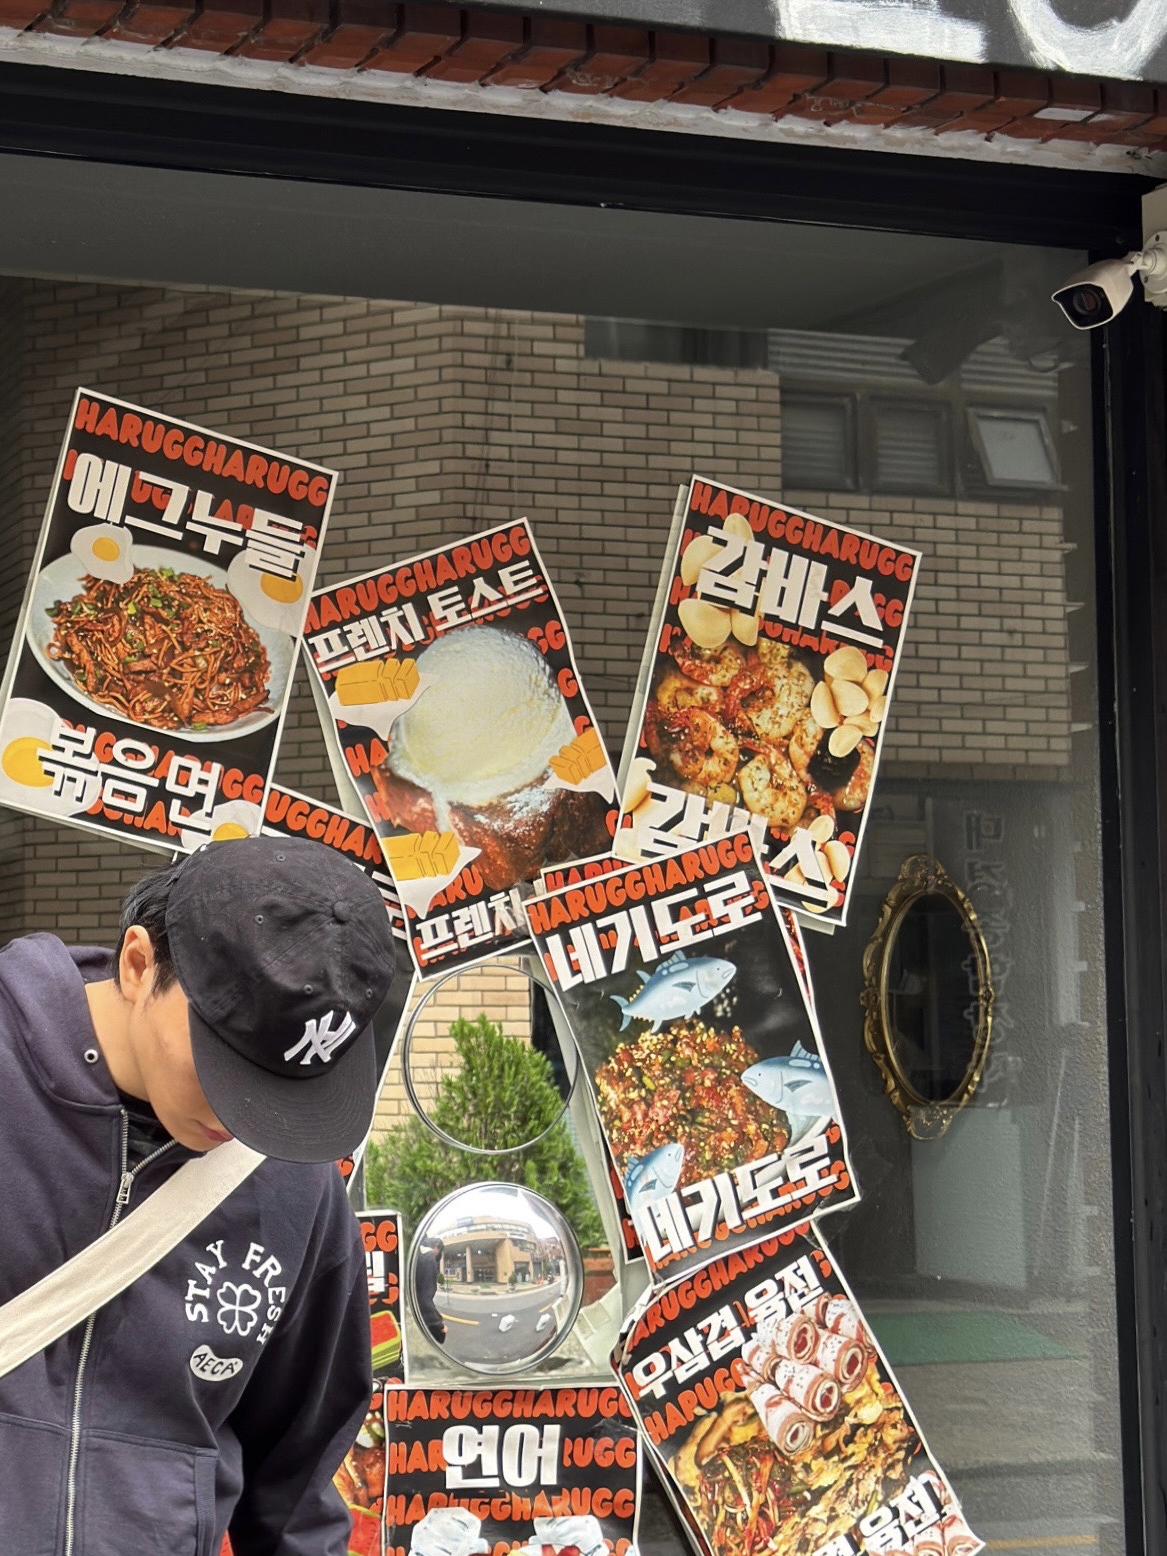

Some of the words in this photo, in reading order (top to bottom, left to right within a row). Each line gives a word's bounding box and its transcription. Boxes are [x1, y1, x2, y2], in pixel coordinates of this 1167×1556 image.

[74, 398, 329, 507] HARUGGHARUGG
[67, 453, 305, 578] 에그누들
[307, 602, 426, 673] 프렌치
[427, 560, 548, 632] 토스트
[696, 525, 884, 649] 감바스
[36, 725, 221, 832] 볶음면
[528, 834, 754, 935] HARUGGHARUGG
[546, 870, 763, 992] 네기도로
[283, 1009, 357, 1066] NY
[636, 1133, 838, 1263] 네기도로
[184, 1239, 228, 1323] STAY
[241, 1241, 287, 1346] FRESH
[632, 1304, 746, 1400] 우삼겹
[442, 1424, 562, 1490] 연어
